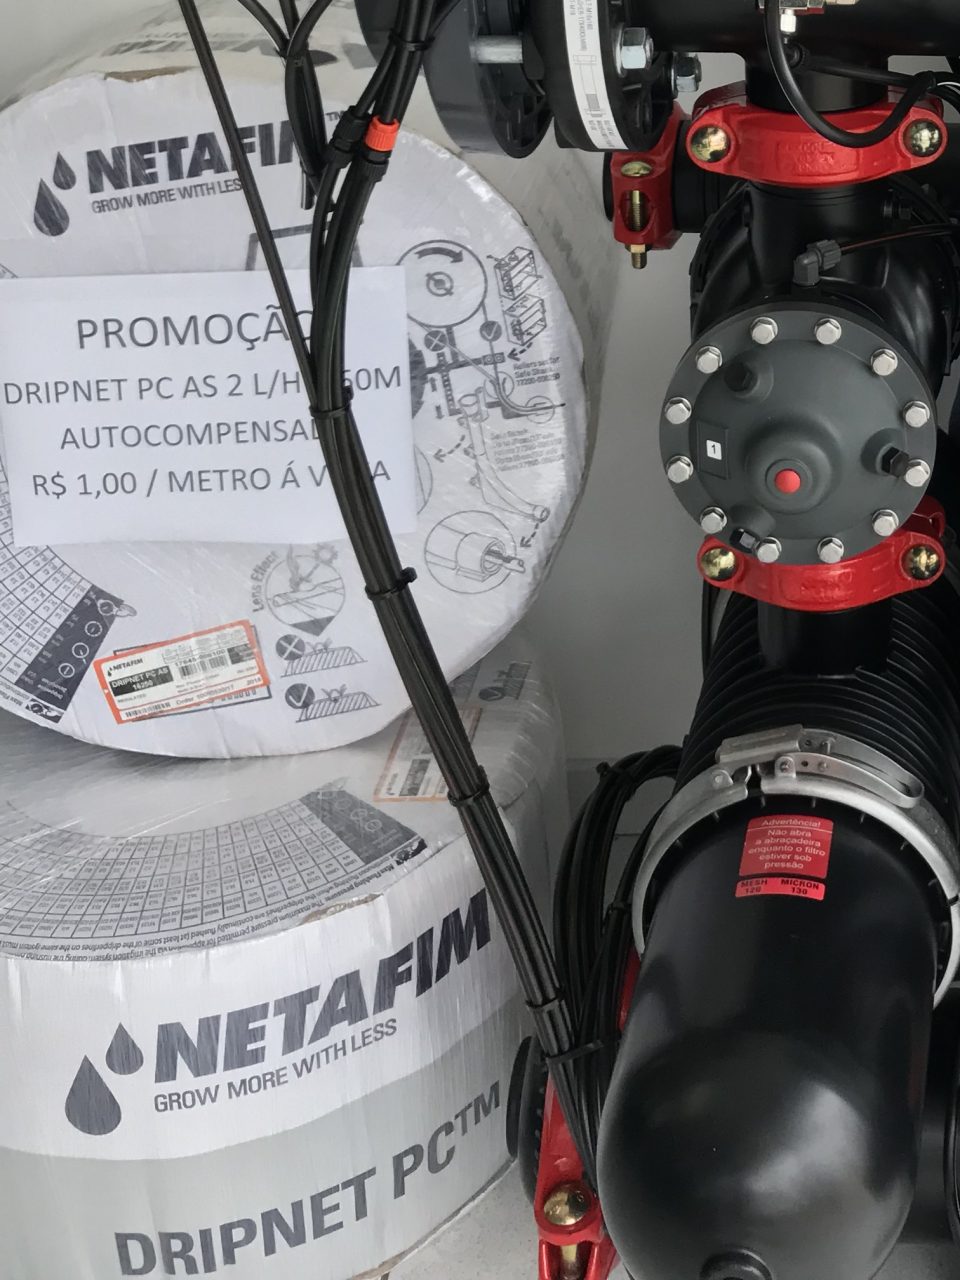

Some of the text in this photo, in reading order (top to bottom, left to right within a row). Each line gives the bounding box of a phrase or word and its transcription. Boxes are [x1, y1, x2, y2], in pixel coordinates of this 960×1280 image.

[91, 194, 133, 214] GROW
[137, 187, 177, 208] MORE
[176, 184, 216, 200] WITH
[4, 377, 127, 405] DRIPNET
[138, 376, 174, 401] PC
[183, 374, 218, 399] AS
[227, 373, 243, 398] 2
[254, 369, 301, 399] L/H
[710, 443, 717, 455] 1
[32, 471, 67, 500] R$
[77, 471, 138, 499] 1,00
[146, 468, 158, 497] /
[168, 466, 272, 493] METRO
[281, 460, 300, 490] Á
[250, 550, 281, 613] Lens Effect
[112, 658, 144, 671] NETAFIM
[111, 667, 169, 688] DRIPNET PC AS
[761, 818, 822, 828] Advertência!
[767, 829, 812, 837] Não abra
[766, 837, 821, 847] abraçadeira
[748, 845, 794, 855] enquanto
[804, 846, 826, 857] filtro
[794, 854, 813, 862] sob
[764, 861, 804, 870] pressão
[740, 879, 820, 890] MESH MICRON
[217, 926, 250, 943] permitted
[153, 887, 492, 1084] NETAFIM
[153, 1018, 398, 1114] GROW MORE WITH LESS
[114, 1166, 377, 1277] DRIPNET
